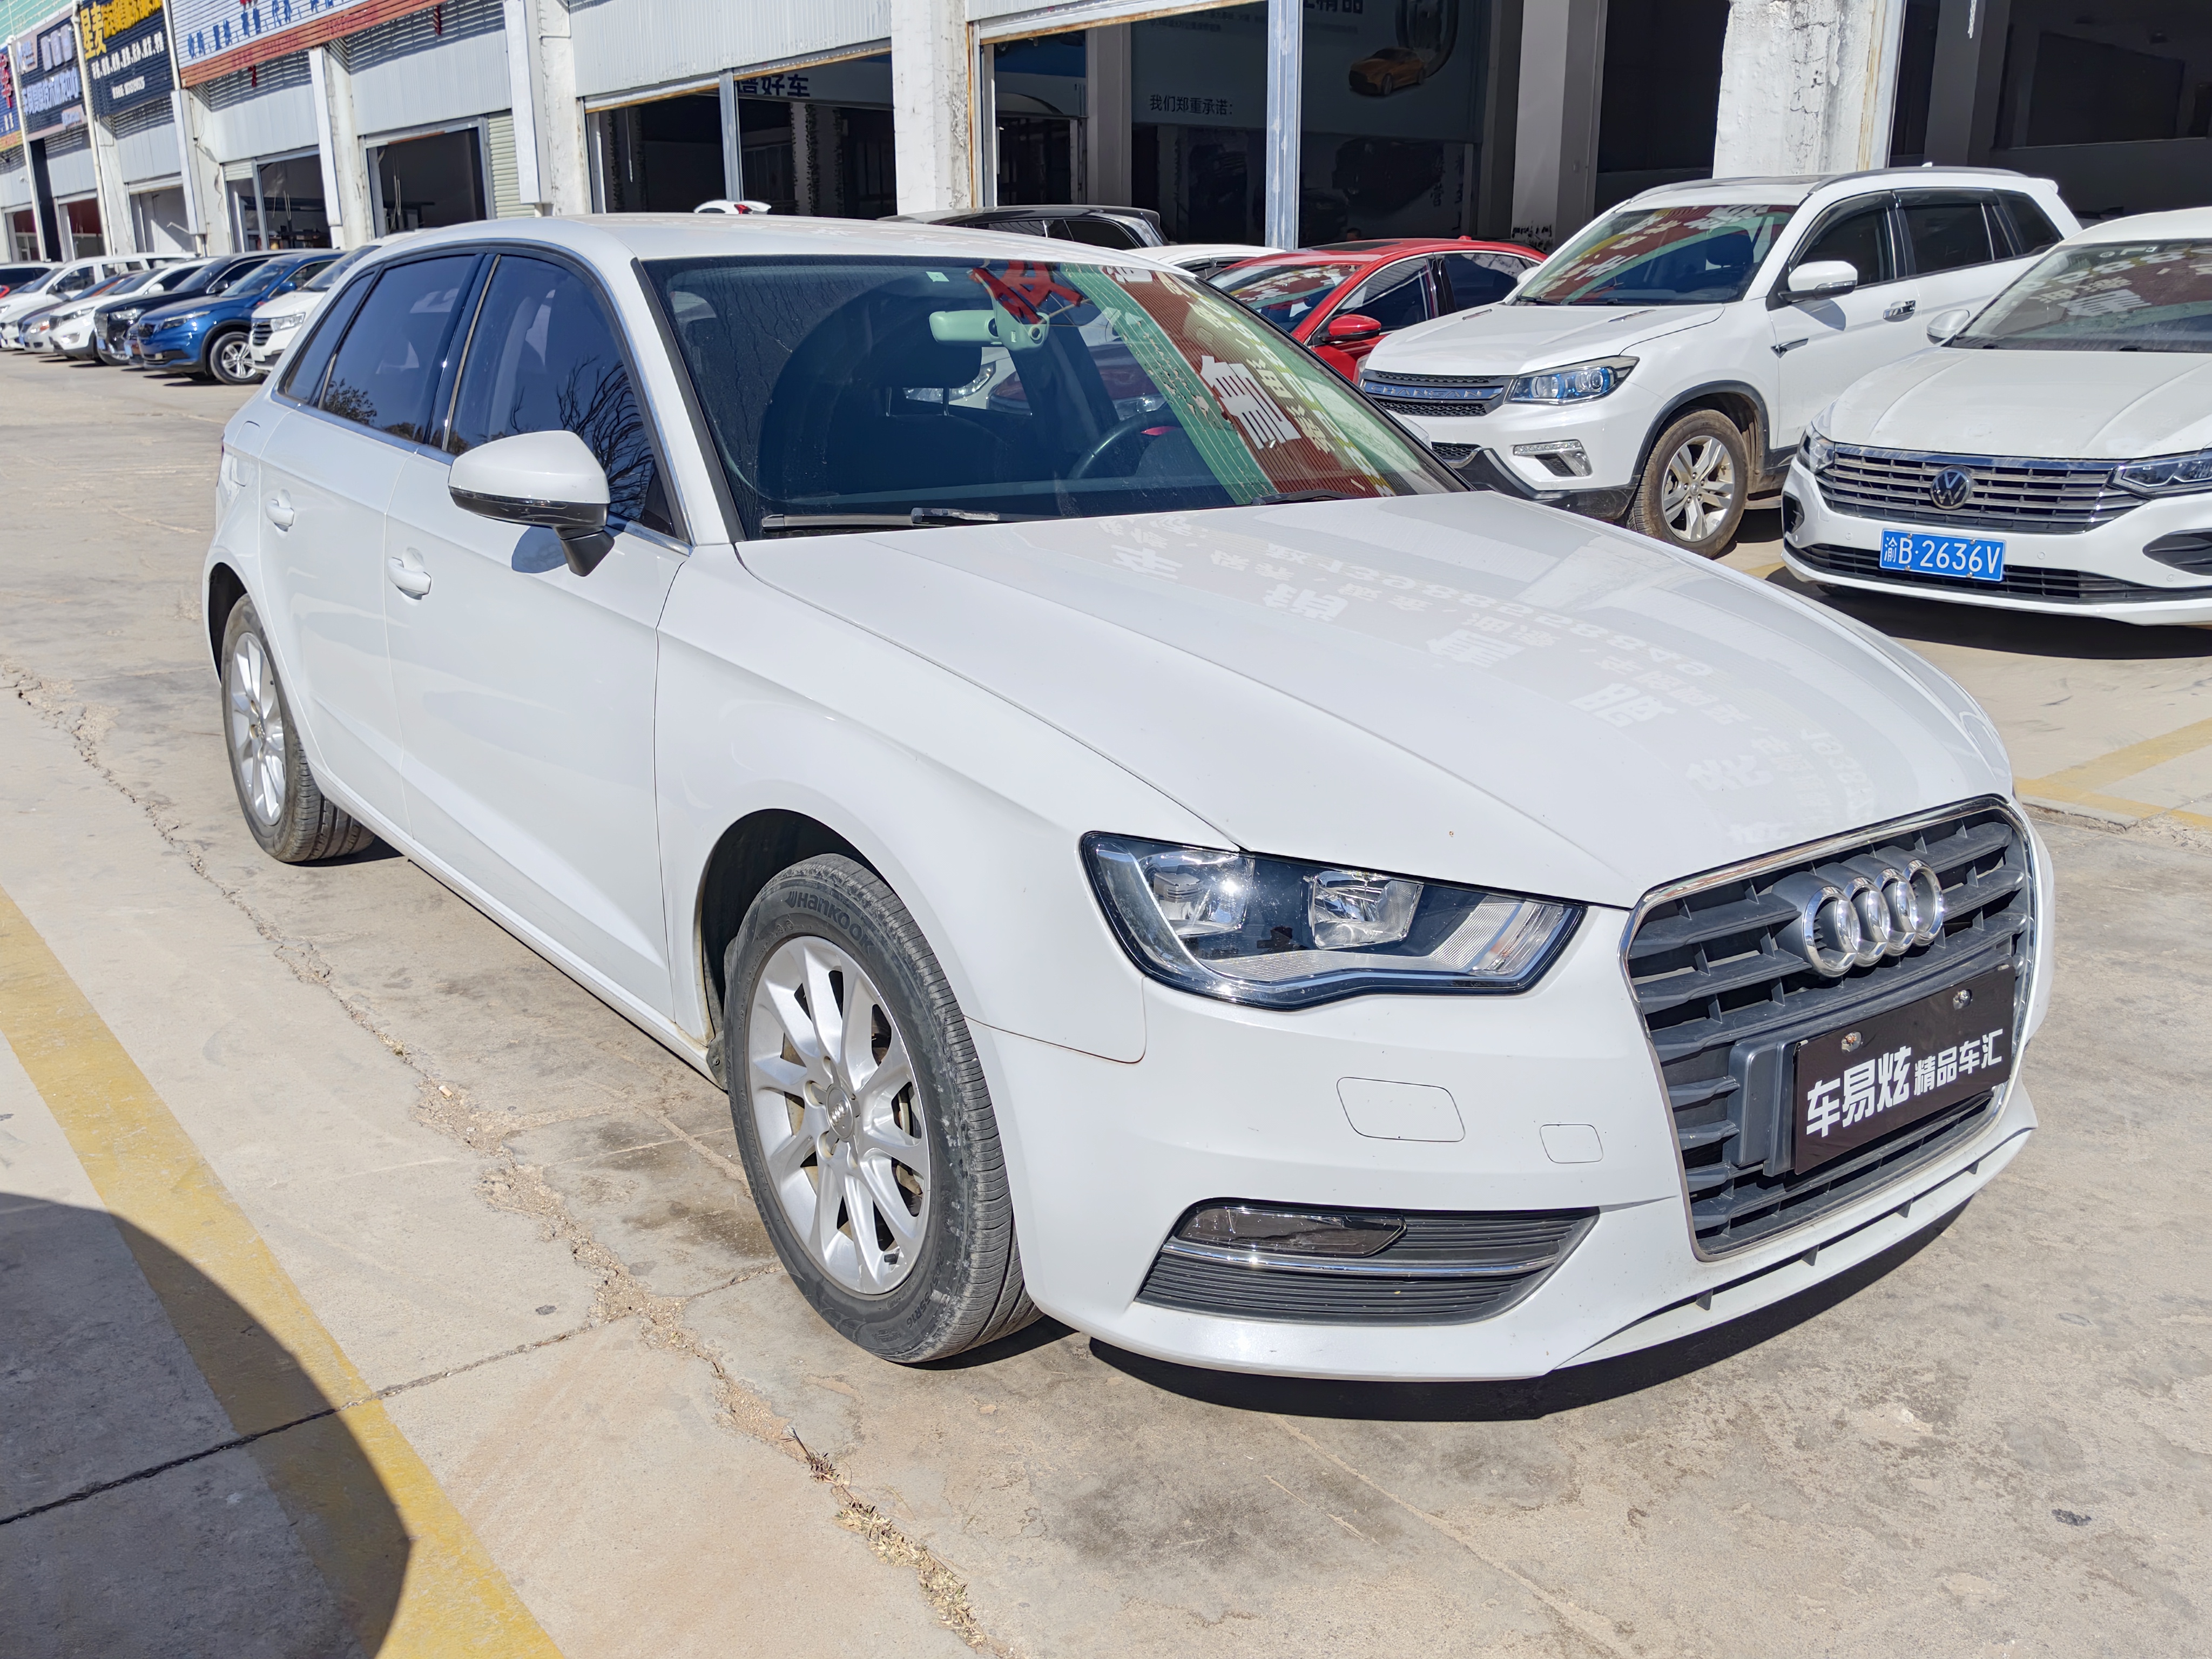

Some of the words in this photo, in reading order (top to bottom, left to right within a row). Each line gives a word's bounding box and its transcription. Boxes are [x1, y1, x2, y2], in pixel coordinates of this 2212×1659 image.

[1371, 385, 1482, 399] CHANGAN
[1805, 1046, 1912, 1137] 车易炫
[1913, 1028, 2004, 1097] 精品车汇
